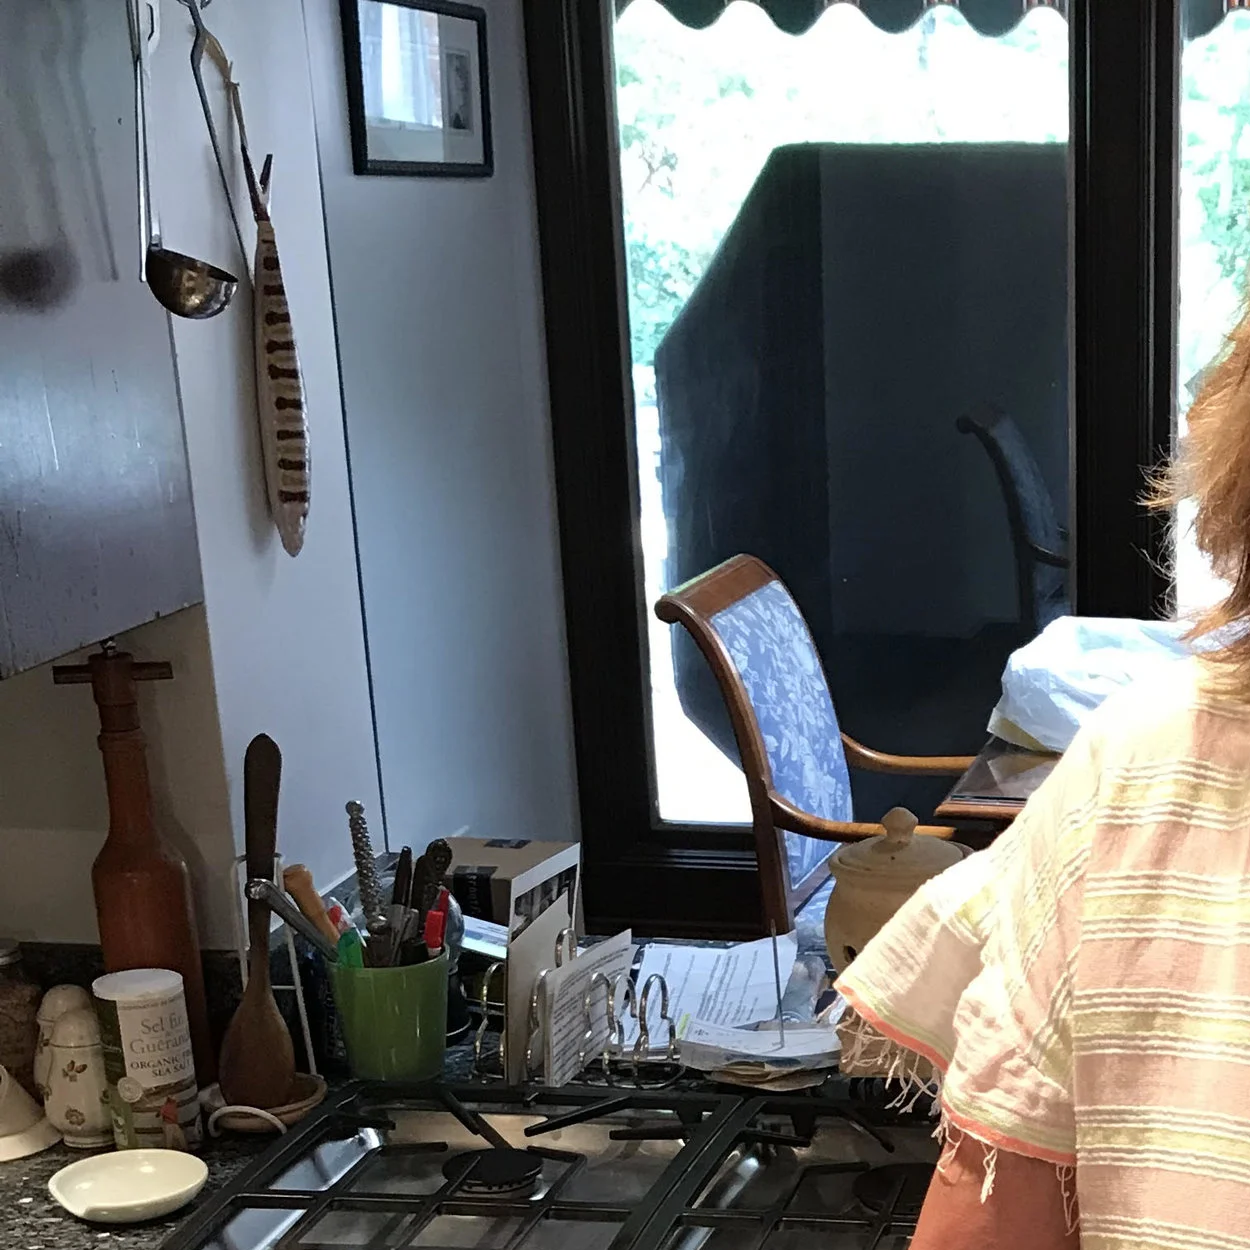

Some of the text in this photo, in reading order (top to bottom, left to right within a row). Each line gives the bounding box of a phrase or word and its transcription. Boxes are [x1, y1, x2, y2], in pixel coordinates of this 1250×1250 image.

[140, 1016, 165, 1035] Sel
[130, 1056, 179, 1070] ORGANIC
[151, 1066, 172, 1077] SEA
